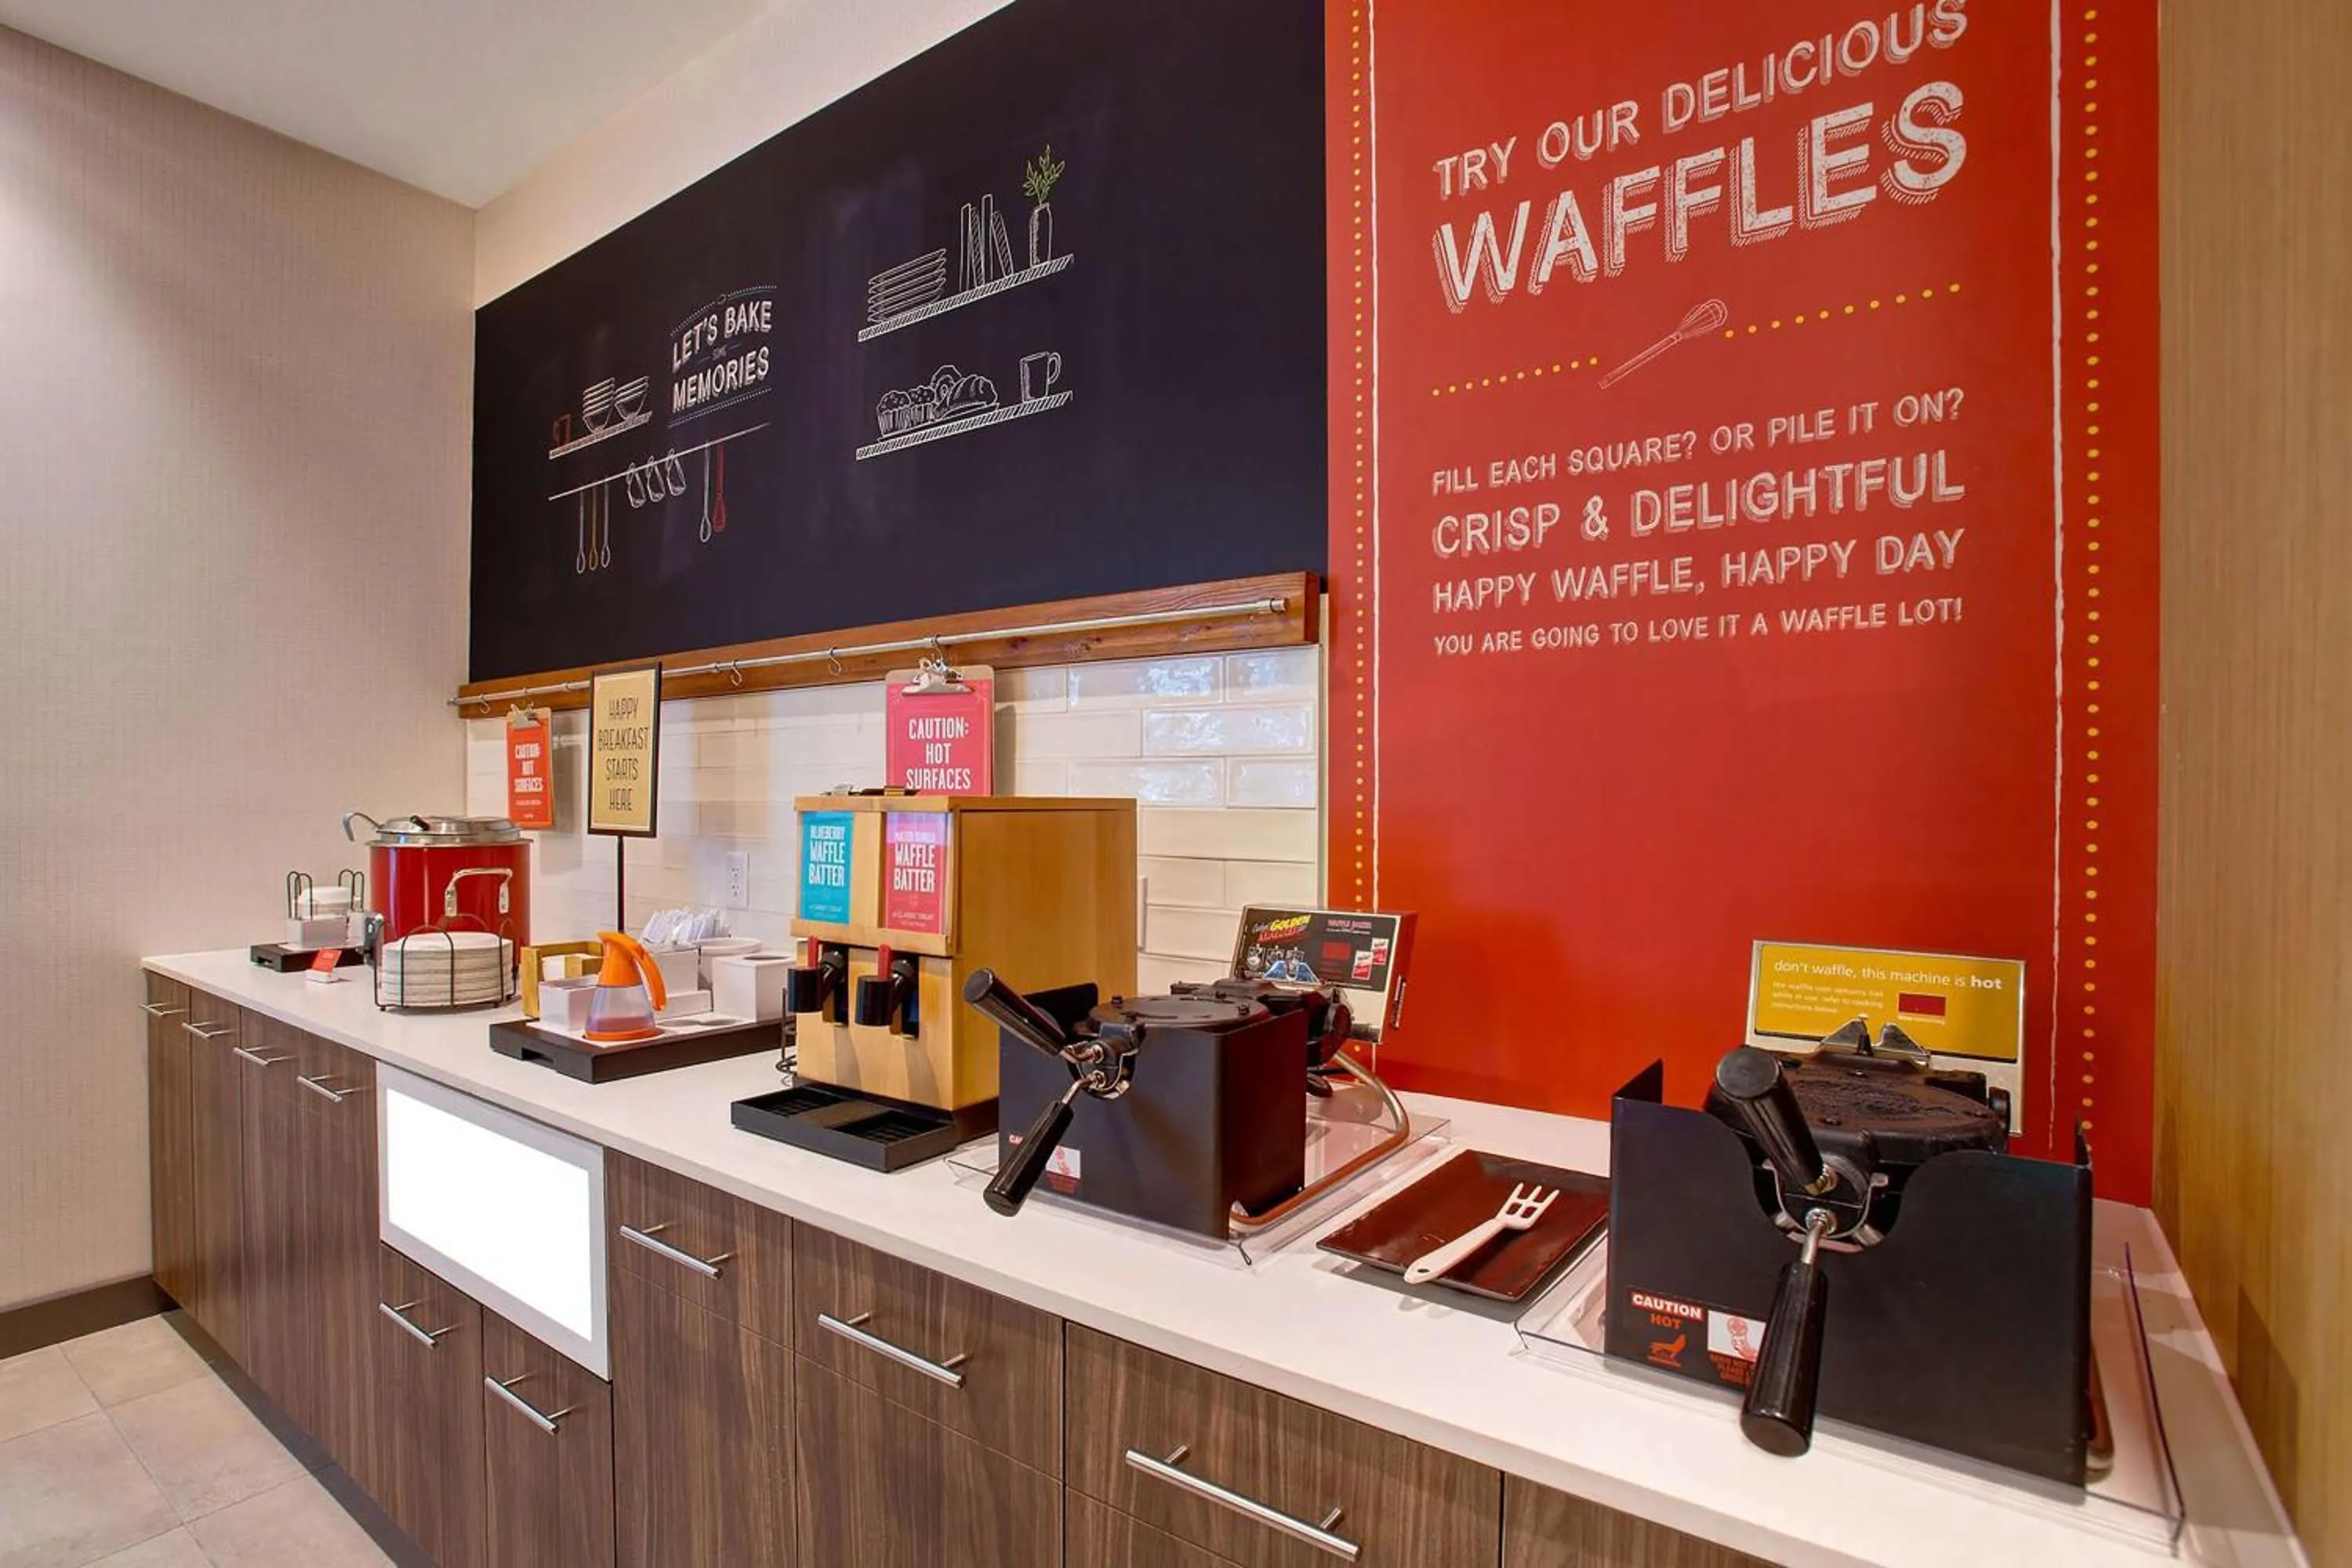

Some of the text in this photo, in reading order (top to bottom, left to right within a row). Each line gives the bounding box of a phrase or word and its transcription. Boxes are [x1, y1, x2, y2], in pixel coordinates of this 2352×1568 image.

[1432, 0, 1968, 201] TRY OUR DELICIOUS
[1430, 81, 1967, 314] WAFFLES
[672, 300, 772, 373] LET'S BAKE
[673, 347, 769, 413] MEMORIES
[1432, 387, 1965, 496] FILL EACH SQUARE? OR PILE IT ON?
[1432, 449, 1965, 558] CRISP & DELIGHTFUL
[1433, 528, 1965, 613] HAPPY WAFFLE, HAPPY DAY
[1434, 597, 1963, 657] YOU ARE GOING TO LOVE IT A WAFFLE LOT!
[608, 696, 640, 720] HAPPY
[598, 726, 650, 753] BREAKFAST
[909, 716, 970, 739] CAUTION:
[925, 743, 952, 765] HOT
[605, 758, 640, 781] STARTS
[906, 768, 971, 790] SURFACES
[608, 788, 633, 812] HERE
[810, 840, 846, 865] WAFFLE
[895, 843, 935, 868] WAFFLE
[808, 863, 844, 887] BATTER
[893, 868, 935, 892] BATTER
[1774, 959, 2004, 990] don't waffle, this machine is hot
[1632, 1293, 1702, 1319] CAUTION
[1650, 1313, 1682, 1330] HOT
